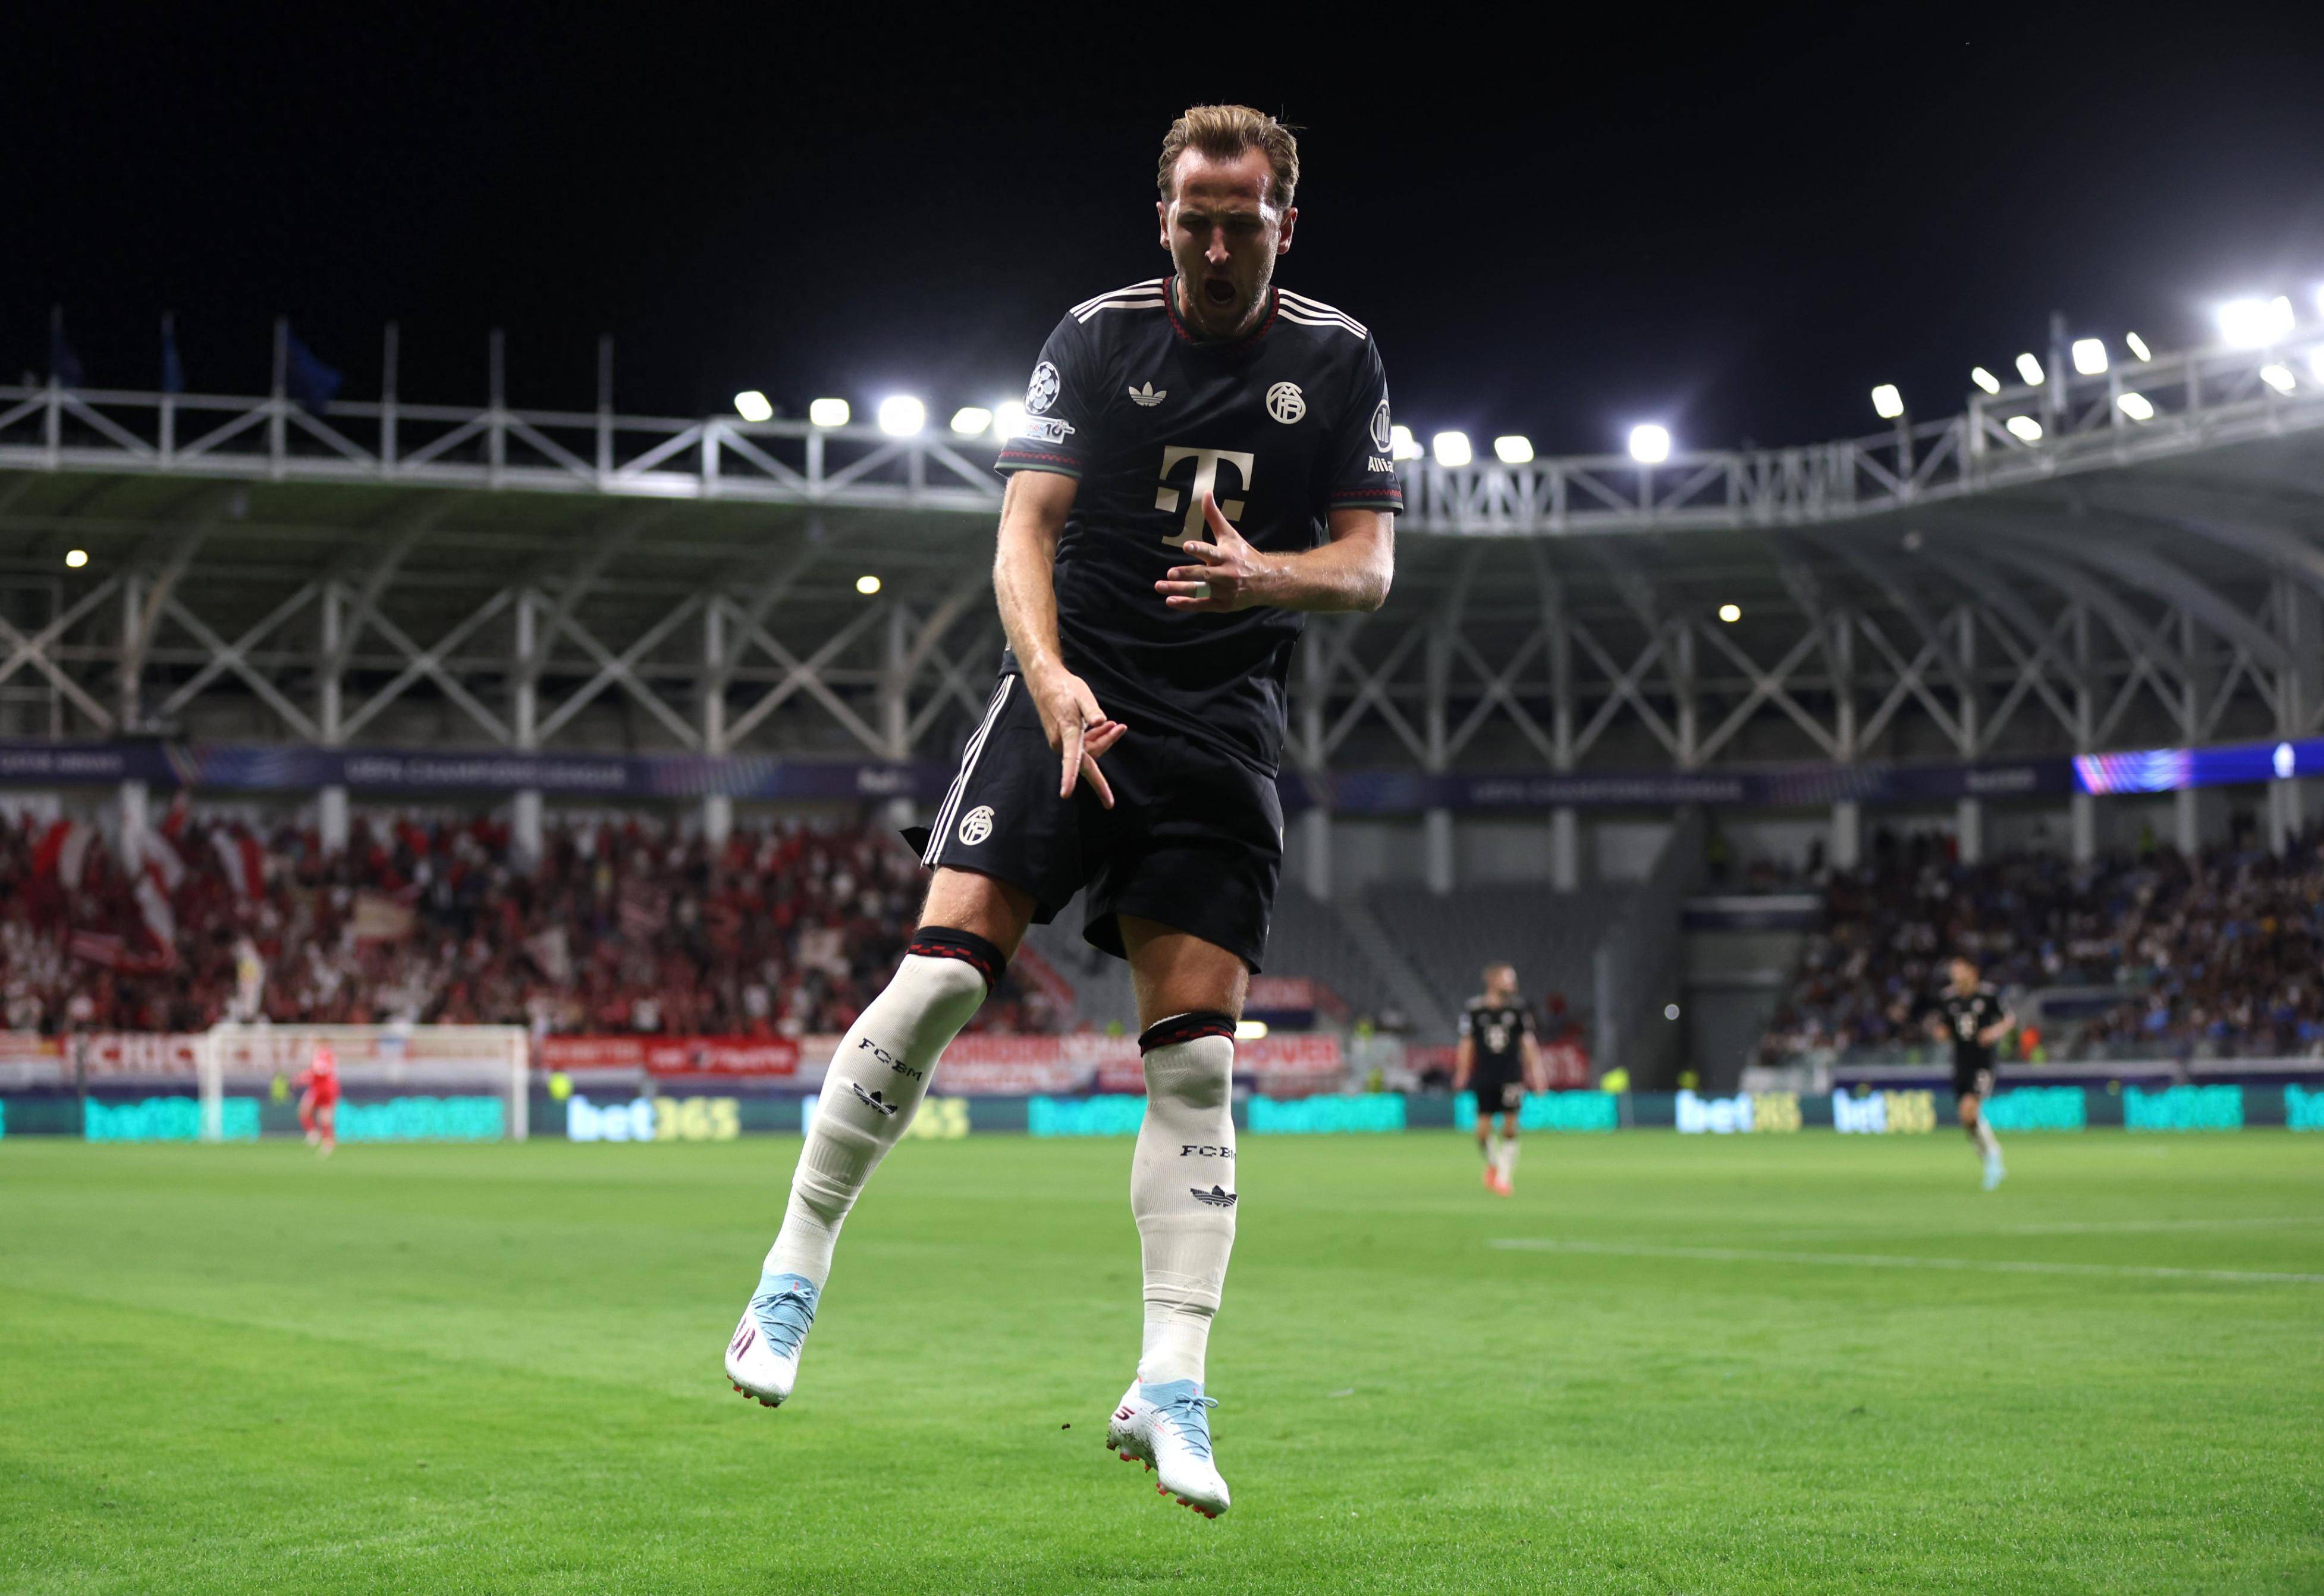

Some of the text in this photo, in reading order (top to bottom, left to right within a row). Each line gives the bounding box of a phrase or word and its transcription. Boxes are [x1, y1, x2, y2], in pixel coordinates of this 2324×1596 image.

[1368, 456, 1393, 473] Allia
[1155, 446, 1254, 548] T
[859, 1037, 922, 1081] FCBM
[567, 1095, 739, 1142] bet365
[1675, 1089, 1802, 1134] bet365
